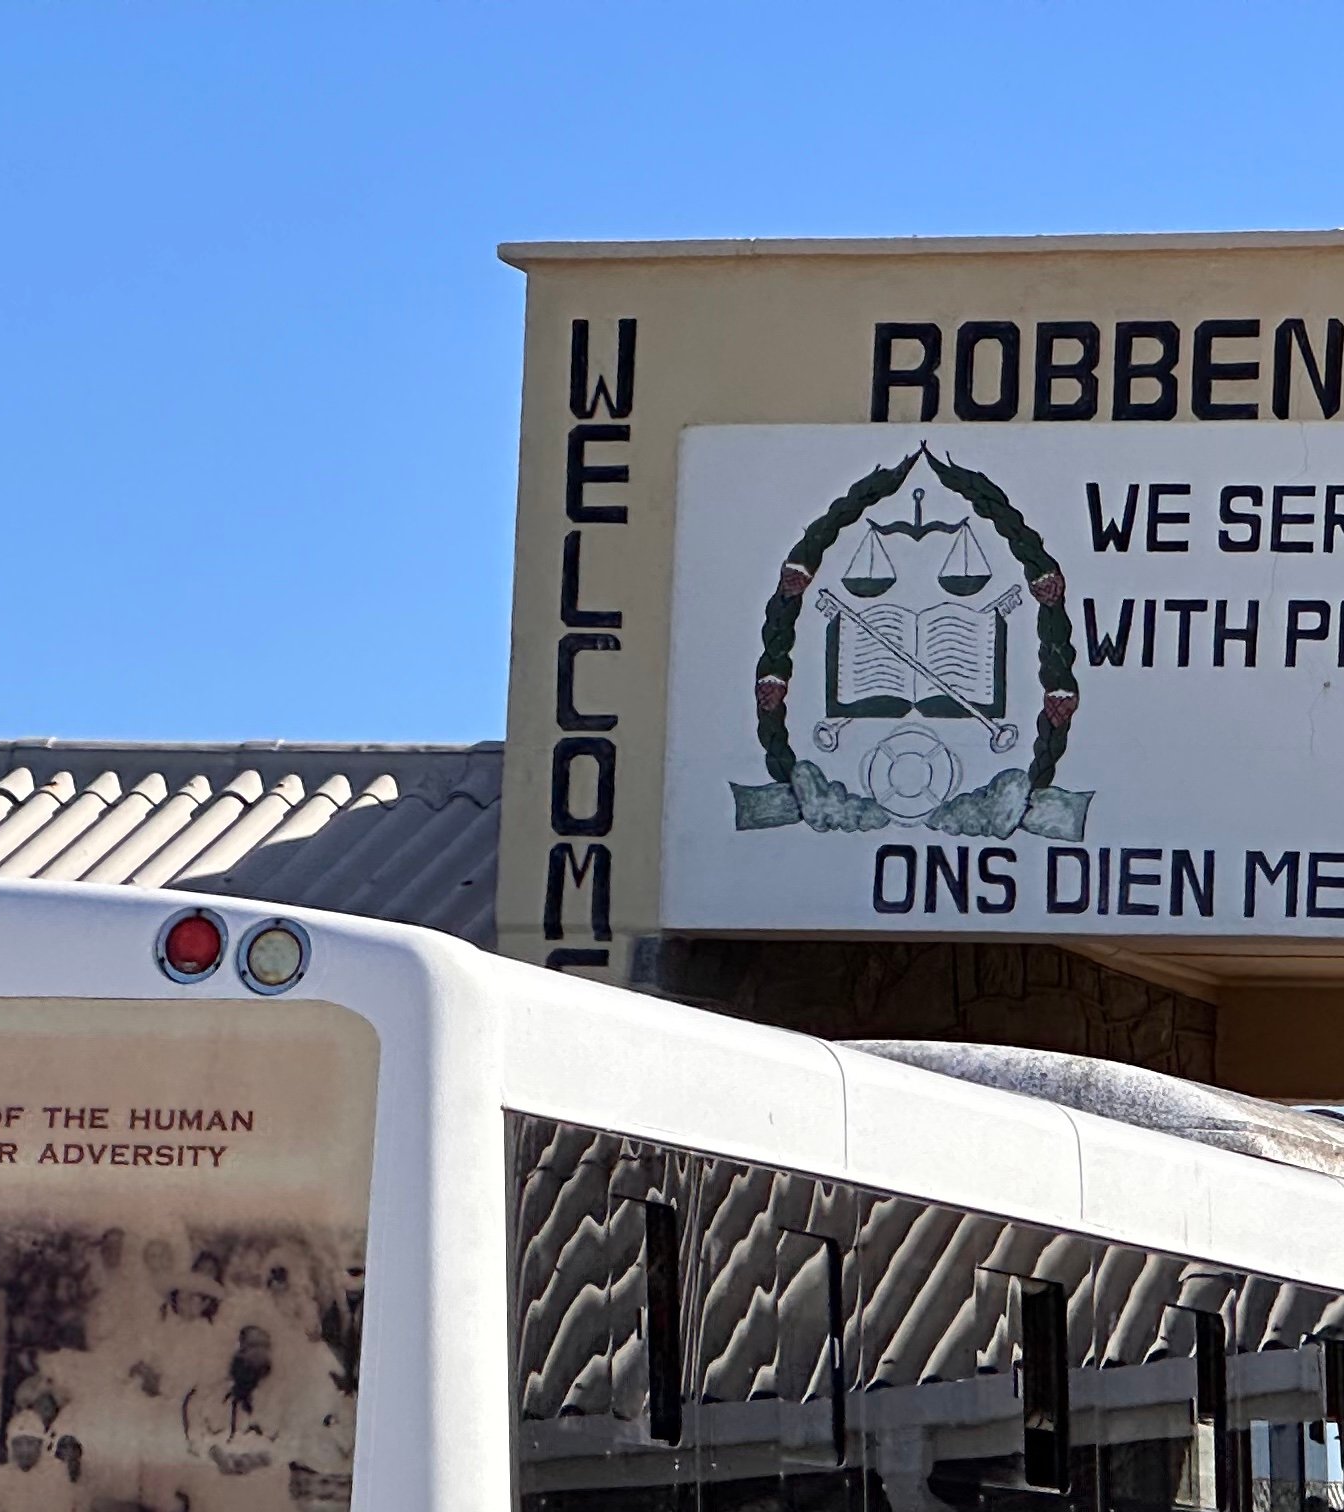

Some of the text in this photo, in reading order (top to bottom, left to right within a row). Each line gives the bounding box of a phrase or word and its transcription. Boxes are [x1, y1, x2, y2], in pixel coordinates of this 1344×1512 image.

[1086, 483, 1192, 553] WE
[543, 318, 638, 970] WELCOM
[1083, 598, 1260, 668] WITH
[872, 844, 1018, 915] ONS
[1046, 846, 1216, 917] DIEN
[42, 1106, 110, 1130] THE
[129, 1108, 254, 1132] HUMAN
[37, 1142, 228, 1168] ADVERSITY
